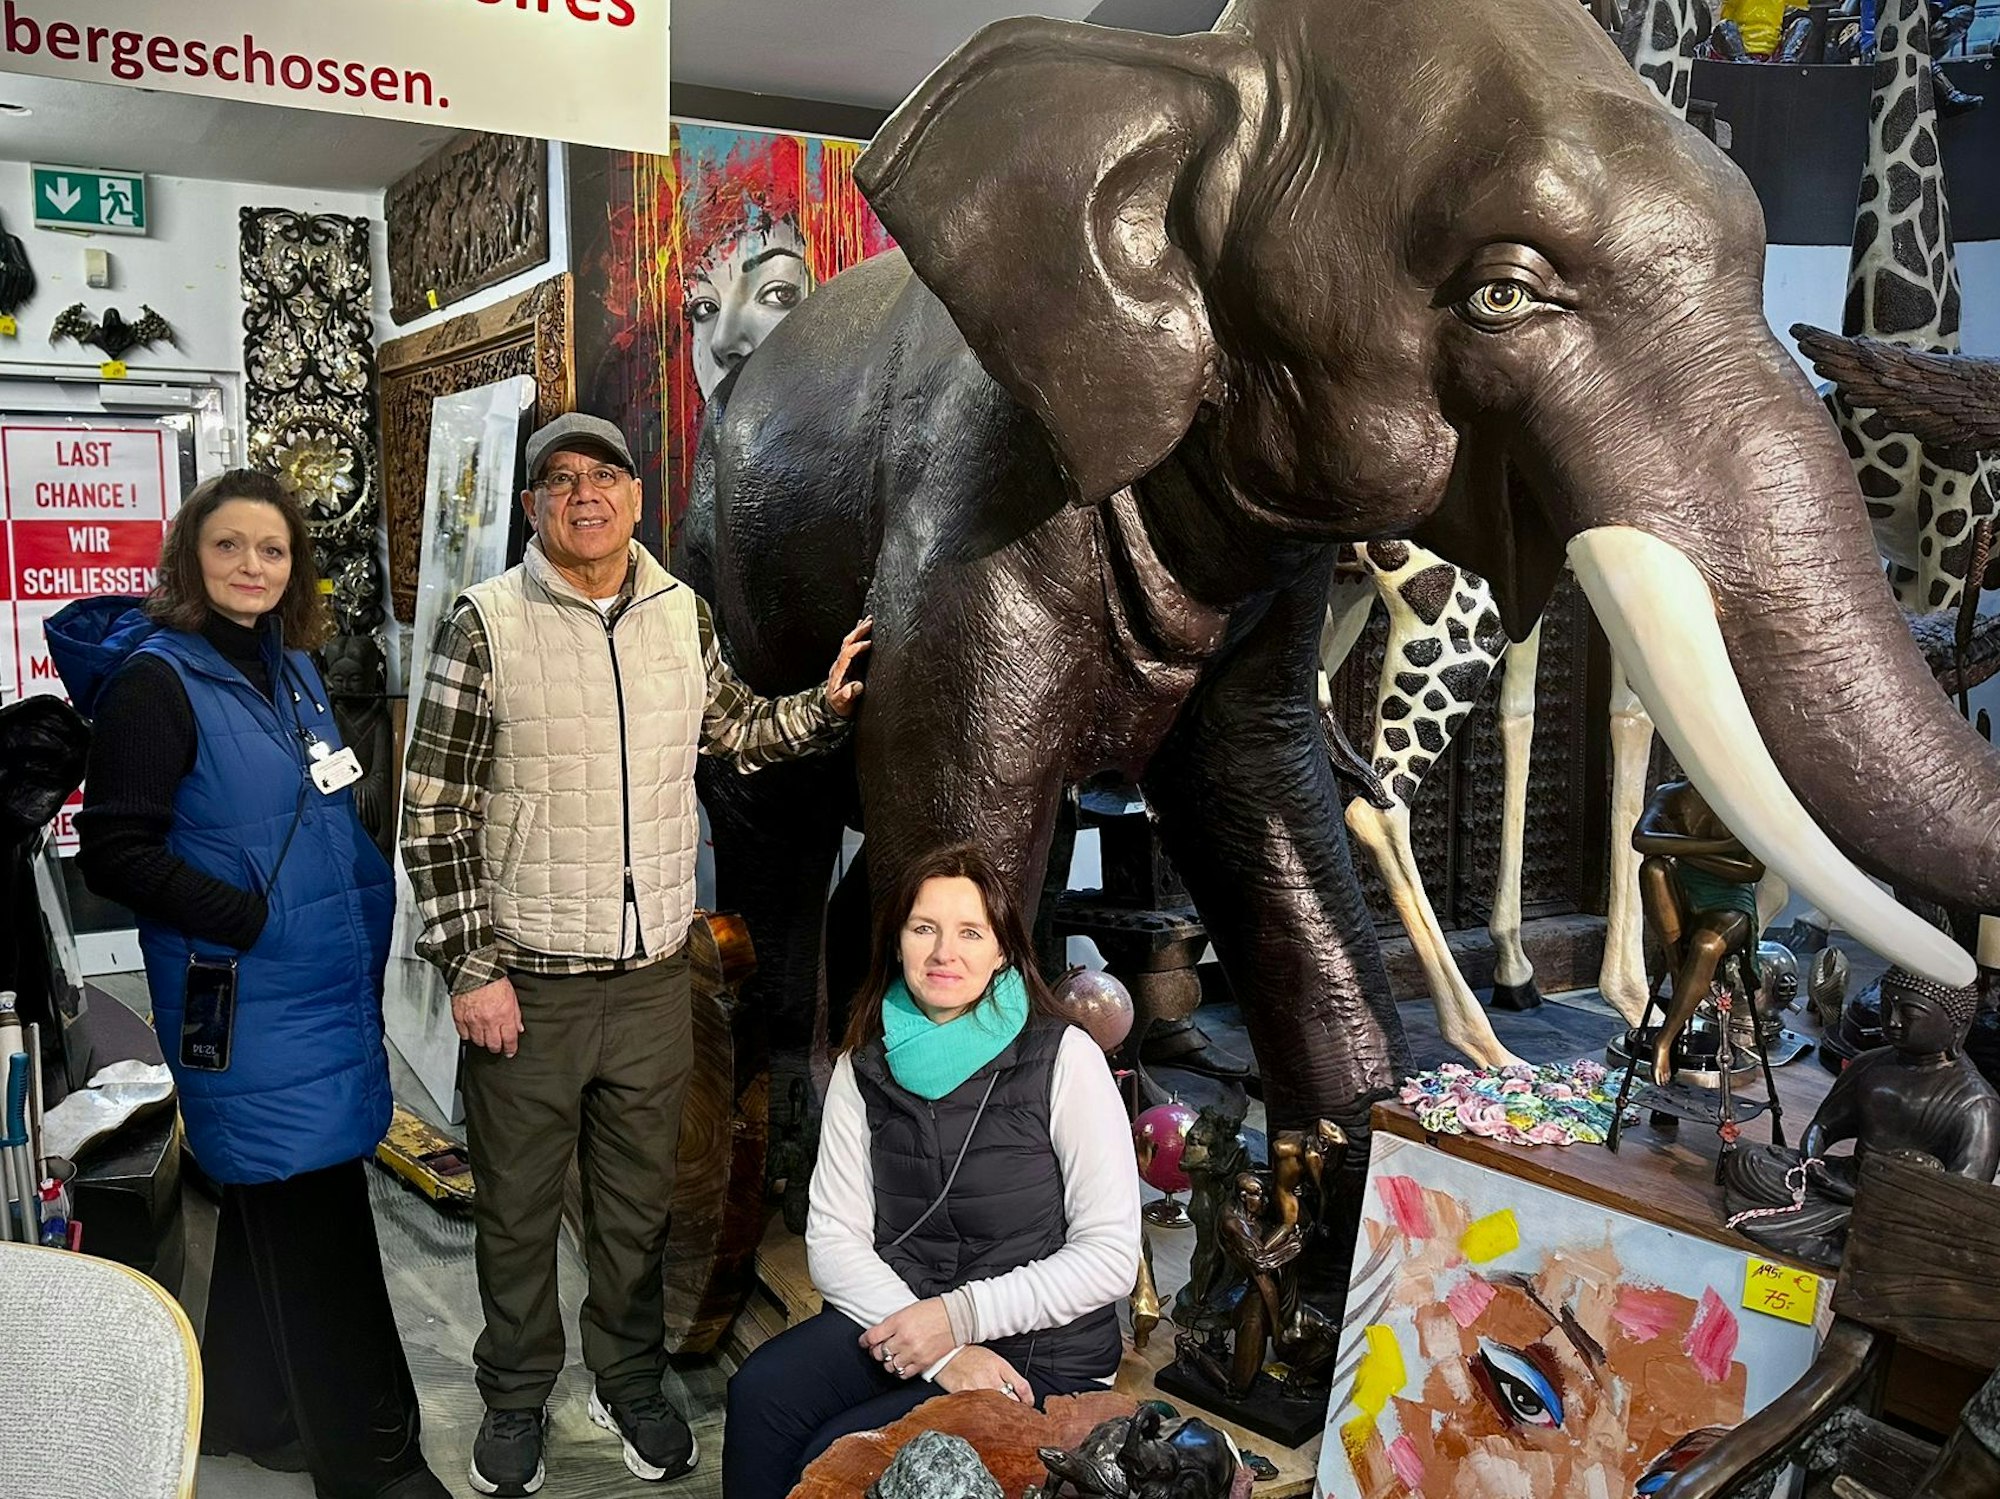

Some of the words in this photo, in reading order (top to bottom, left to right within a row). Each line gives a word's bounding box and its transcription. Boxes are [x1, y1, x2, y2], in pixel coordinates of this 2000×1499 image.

[4, 0, 449, 108] bergeschossen.
[56, 441, 112, 467] LAST
[35, 482, 125, 508] CHANCE
[68, 526, 111, 553] WIR
[23, 566, 158, 595] SCHLIESSEN
